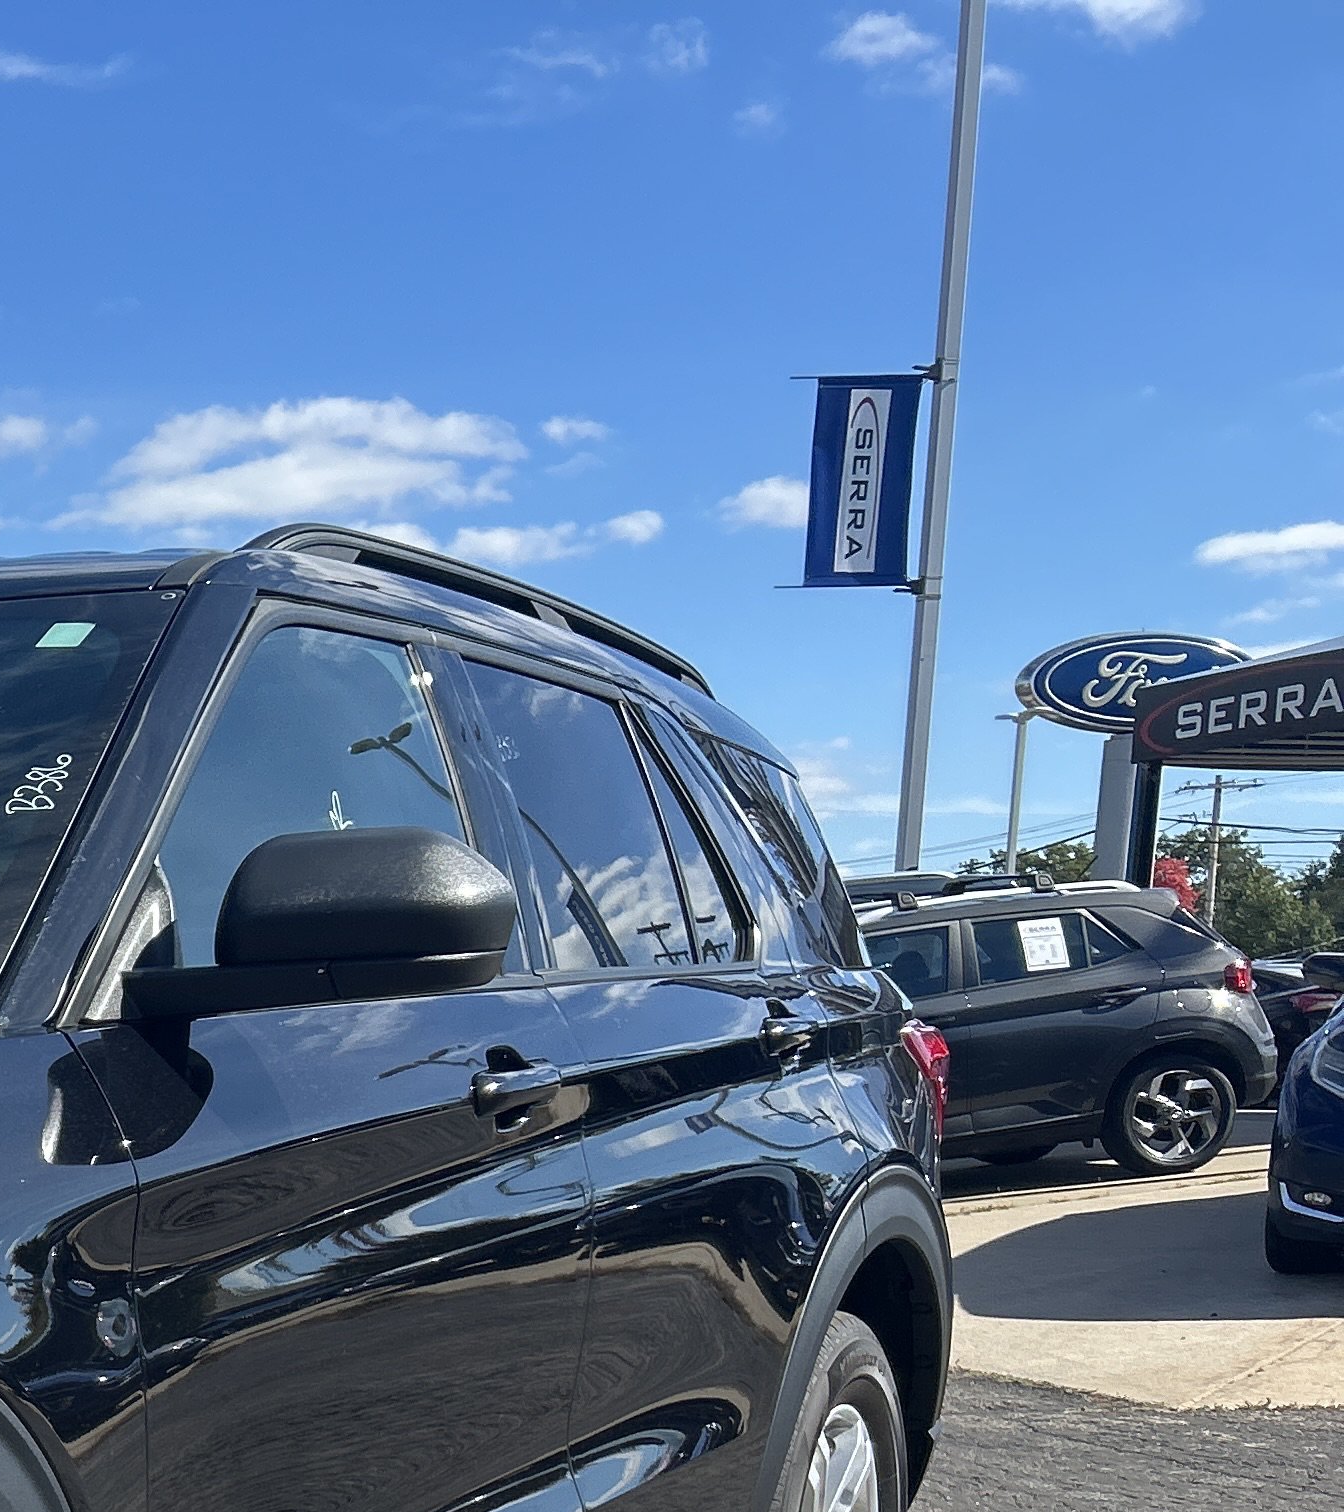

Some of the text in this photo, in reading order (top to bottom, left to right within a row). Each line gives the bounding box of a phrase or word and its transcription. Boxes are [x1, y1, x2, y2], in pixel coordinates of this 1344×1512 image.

[844, 428, 873, 559] SERRA
[1082, 650, 1220, 708] Fo
[1175, 678, 1344, 739] SERRA
